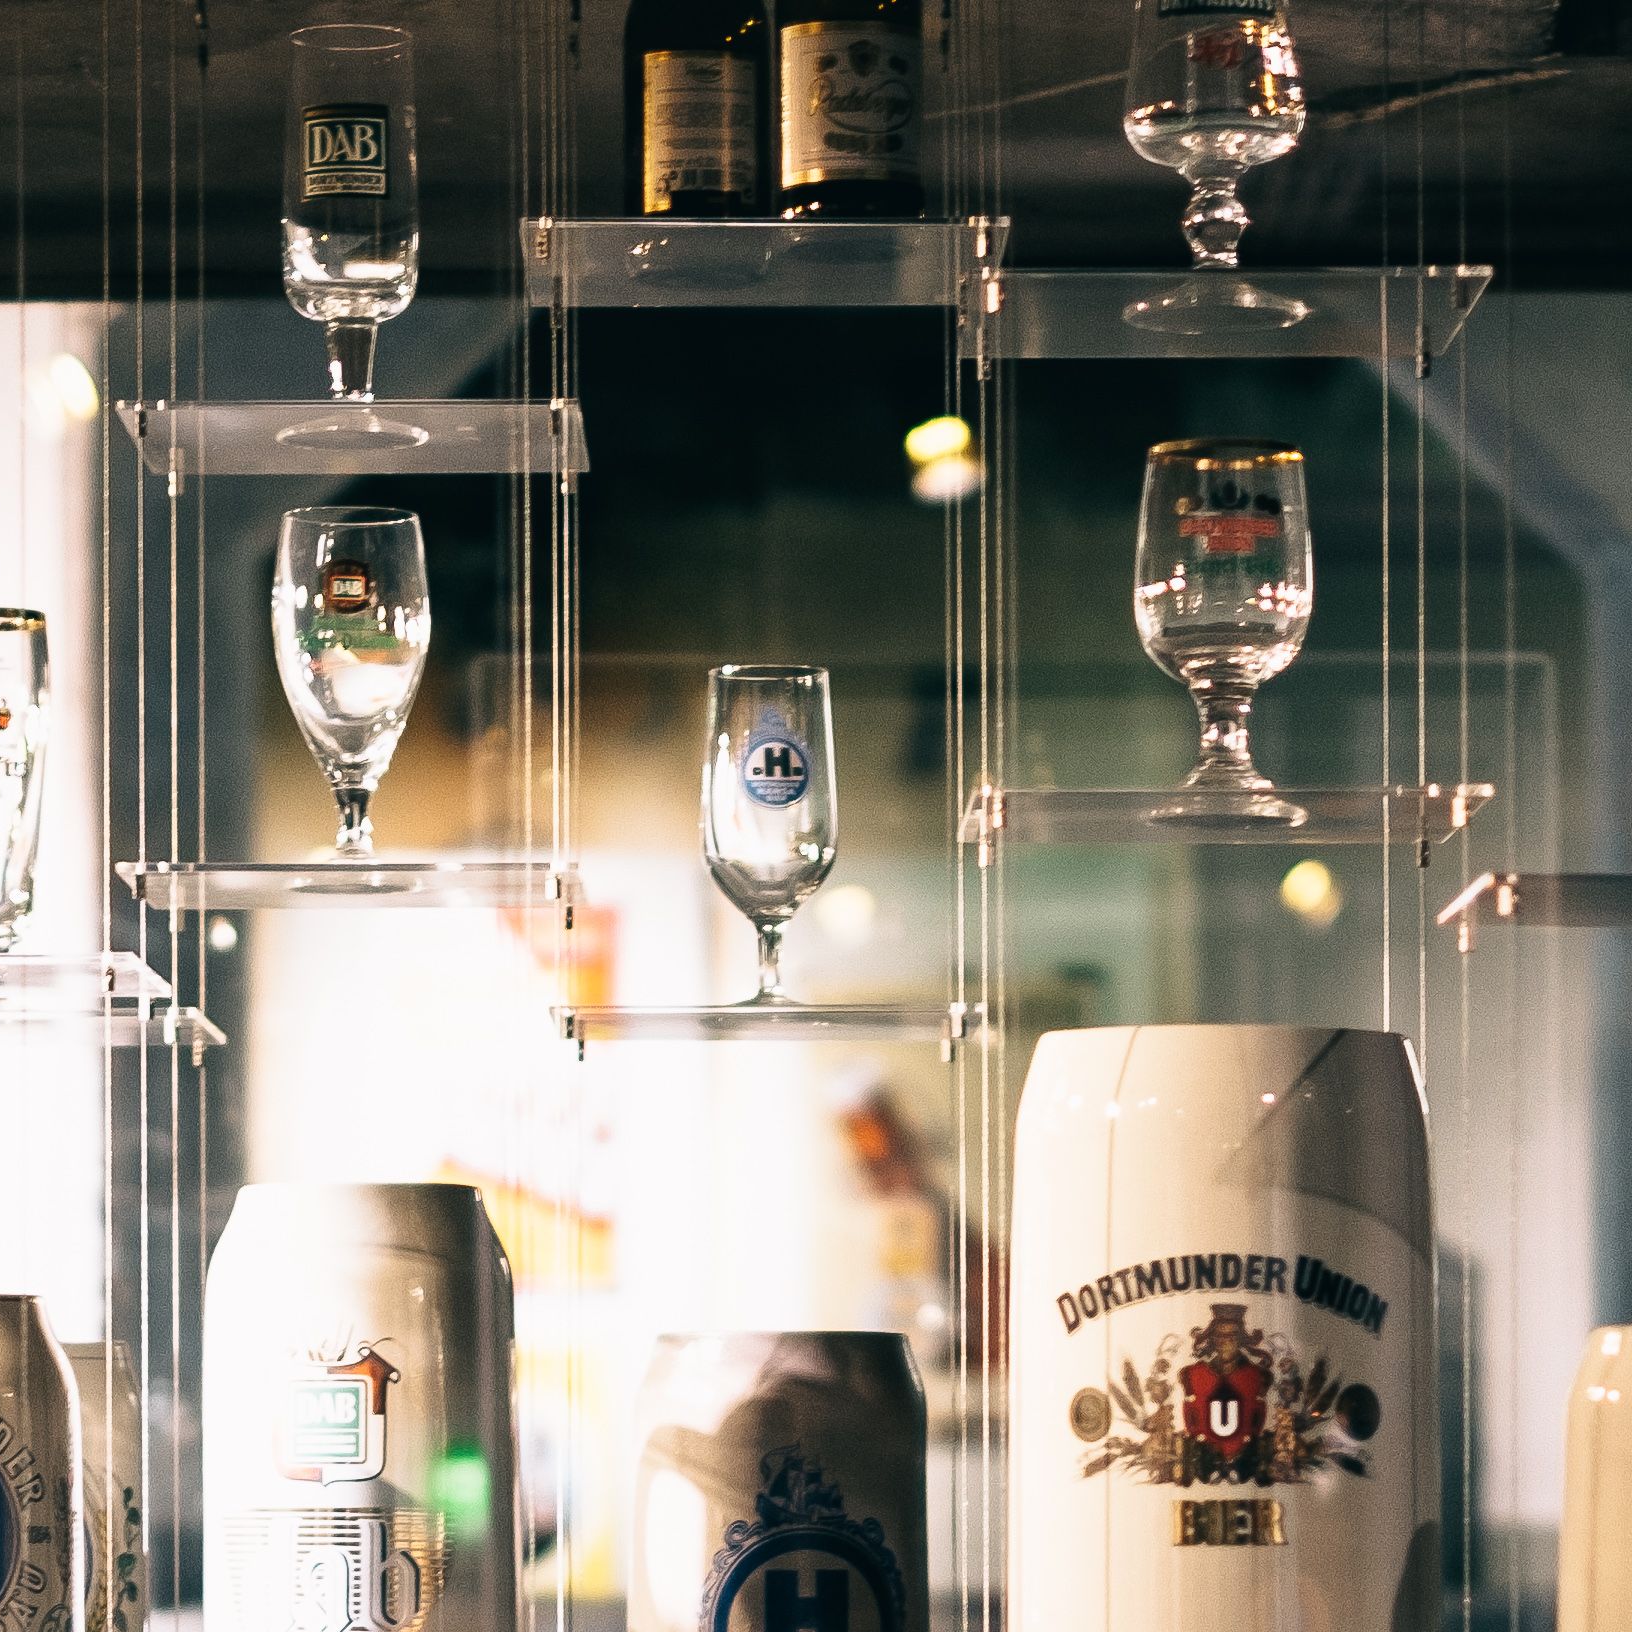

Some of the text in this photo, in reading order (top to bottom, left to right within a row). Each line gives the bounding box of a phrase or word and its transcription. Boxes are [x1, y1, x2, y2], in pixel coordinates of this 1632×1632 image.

[311, 124, 378, 164] DAB
[1056, 1253, 1390, 1336] DORTMUNDER UNION
[1209, 1400, 1239, 1437] U
